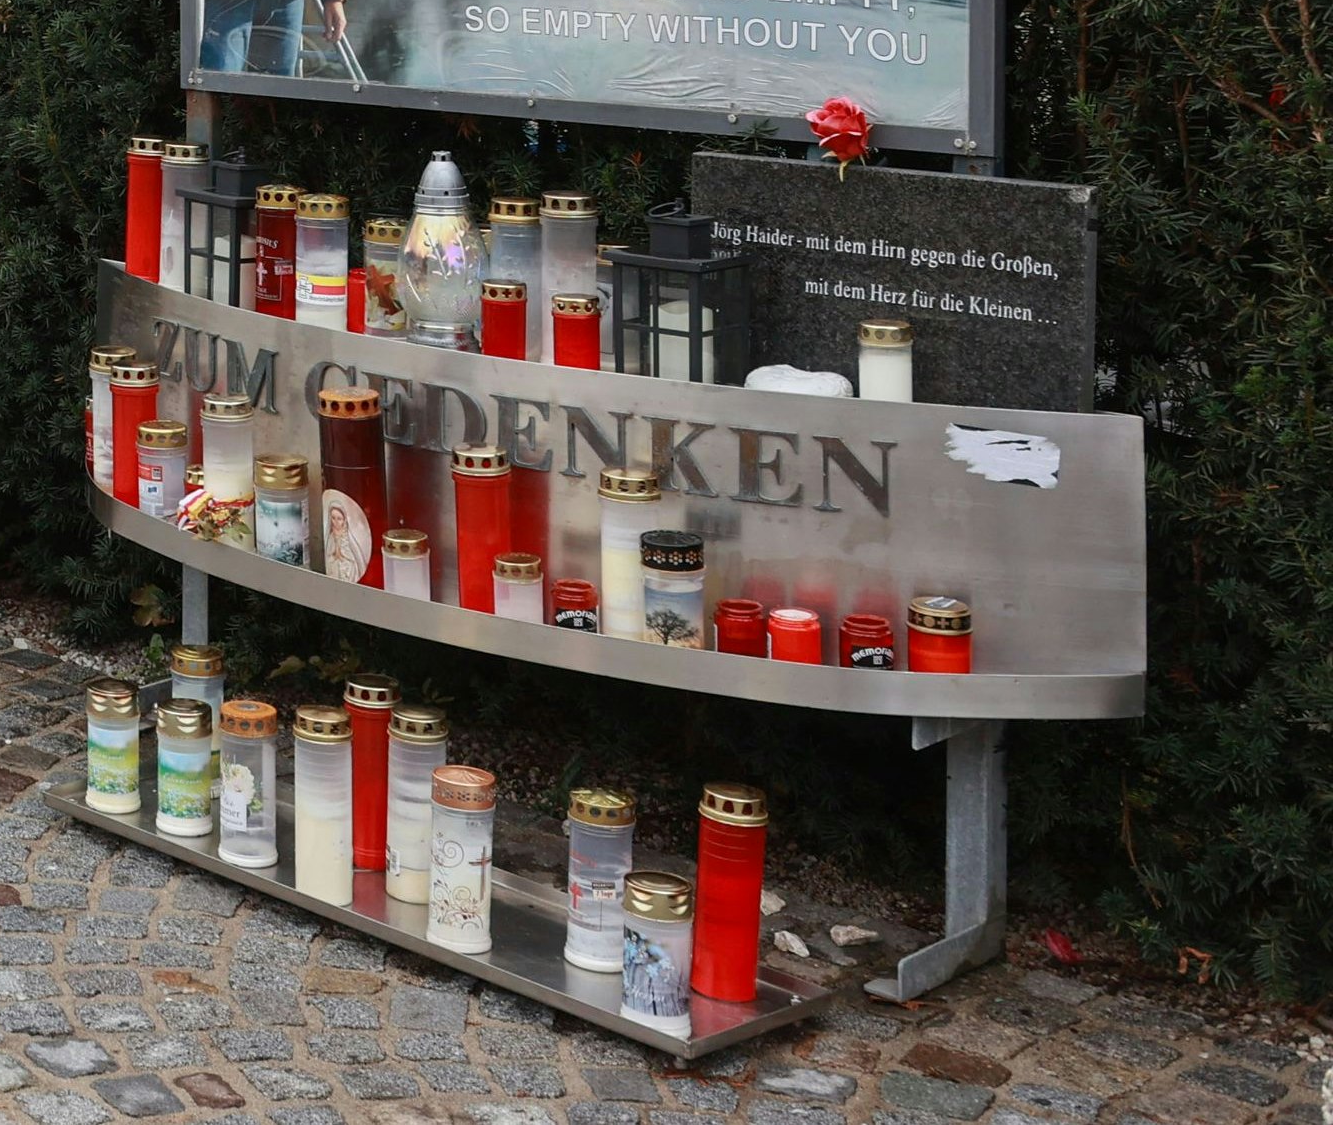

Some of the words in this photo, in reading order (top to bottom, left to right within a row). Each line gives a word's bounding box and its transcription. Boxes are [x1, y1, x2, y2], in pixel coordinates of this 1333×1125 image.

[465, 5, 510, 33] SO
[522, 7, 637, 42] EMPTY
[646, 13, 826, 52] WITHOUT
[837, 23, 928, 65] YOU
[710, 221, 742, 246] Jörg
[745, 225, 795, 247] Haider
[805, 233, 830, 251] mit
[834, 235, 867, 255] dem
[871, 238, 906, 260] Hirn
[910, 247, 956, 269] gegen
[961, 249, 986, 269] die
[991, 252, 1059, 280] Großen,
[805, 278, 830, 296] mit
[833, 280, 866, 300] dem
[870, 283, 907, 306] Herz
[911, 288, 936, 309] für
[940, 293, 965, 313] die
[968, 296, 1033, 322] Kleinen
[152, 321, 279, 416] ZUM
[304, 360, 899, 518] GEDENKEN
